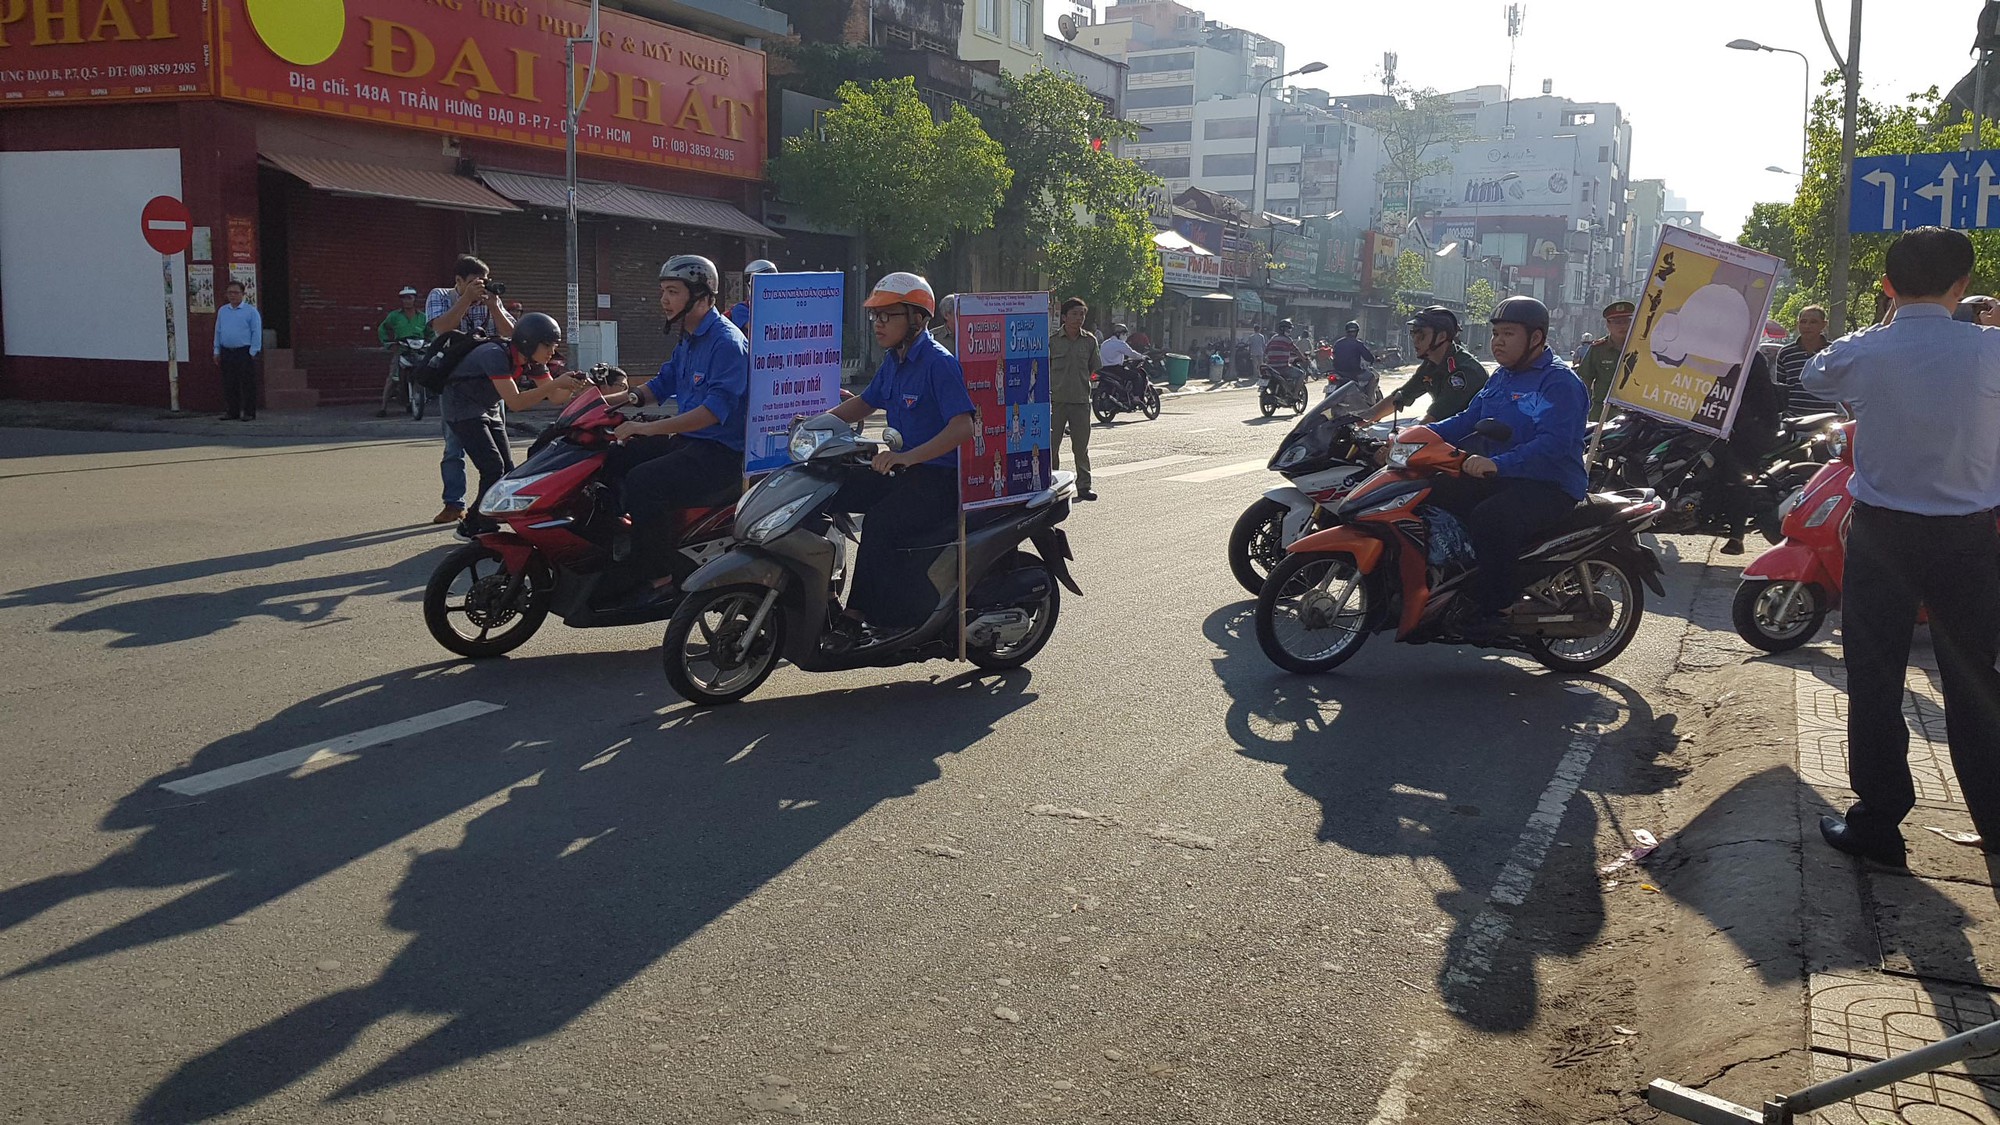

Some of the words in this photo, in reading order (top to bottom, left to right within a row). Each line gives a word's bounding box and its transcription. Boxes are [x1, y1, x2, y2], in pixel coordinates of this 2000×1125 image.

[620, 35, 637, 53] &
[642, 40, 675, 62] MỸ
[680, 51, 731, 80] NGHỆ
[27, 70, 49, 83] ĐẠO
[108, 65, 128, 77] ĐT:
[129, 64, 146, 78] (08)
[148, 63, 170, 75] 3859
[173, 62, 196, 74] 2985
[360, 16, 542, 103] ĐẠI
[558, 61, 754, 142] PHÁT
[289, 71, 316, 92] Địa
[354, 83, 390, 103] 148A
[399, 88, 439, 111] TRẦN
[445, 99, 482, 118] HƯNG
[488, 108, 514, 125] ĐẠO
[606, 129, 631, 143] HCM
[652, 135, 669, 150] ĐT:
[764, 322, 780, 341] Phải
[810, 324, 818, 338] an
[819, 321, 833, 337] toàn
[967, 322, 975, 354] 3
[1010, 321, 1017, 351] 3
[754, 354, 765, 370] lao
[794, 349, 812, 367] người
[813, 349, 823, 365] lao
[824, 348, 840, 367] động
[975, 339, 986, 353] TAI
[772, 380, 779, 396] là
[781, 377, 792, 395] vốn
[806, 373, 821, 392] nhất
[1671, 372, 1692, 390] AN
[1694, 377, 1732, 401] TOÀN
[1642, 384, 1660, 403] LÀ
[1663, 390, 1697, 412] TRÊN
[1697, 401, 1726, 421] HẾT
